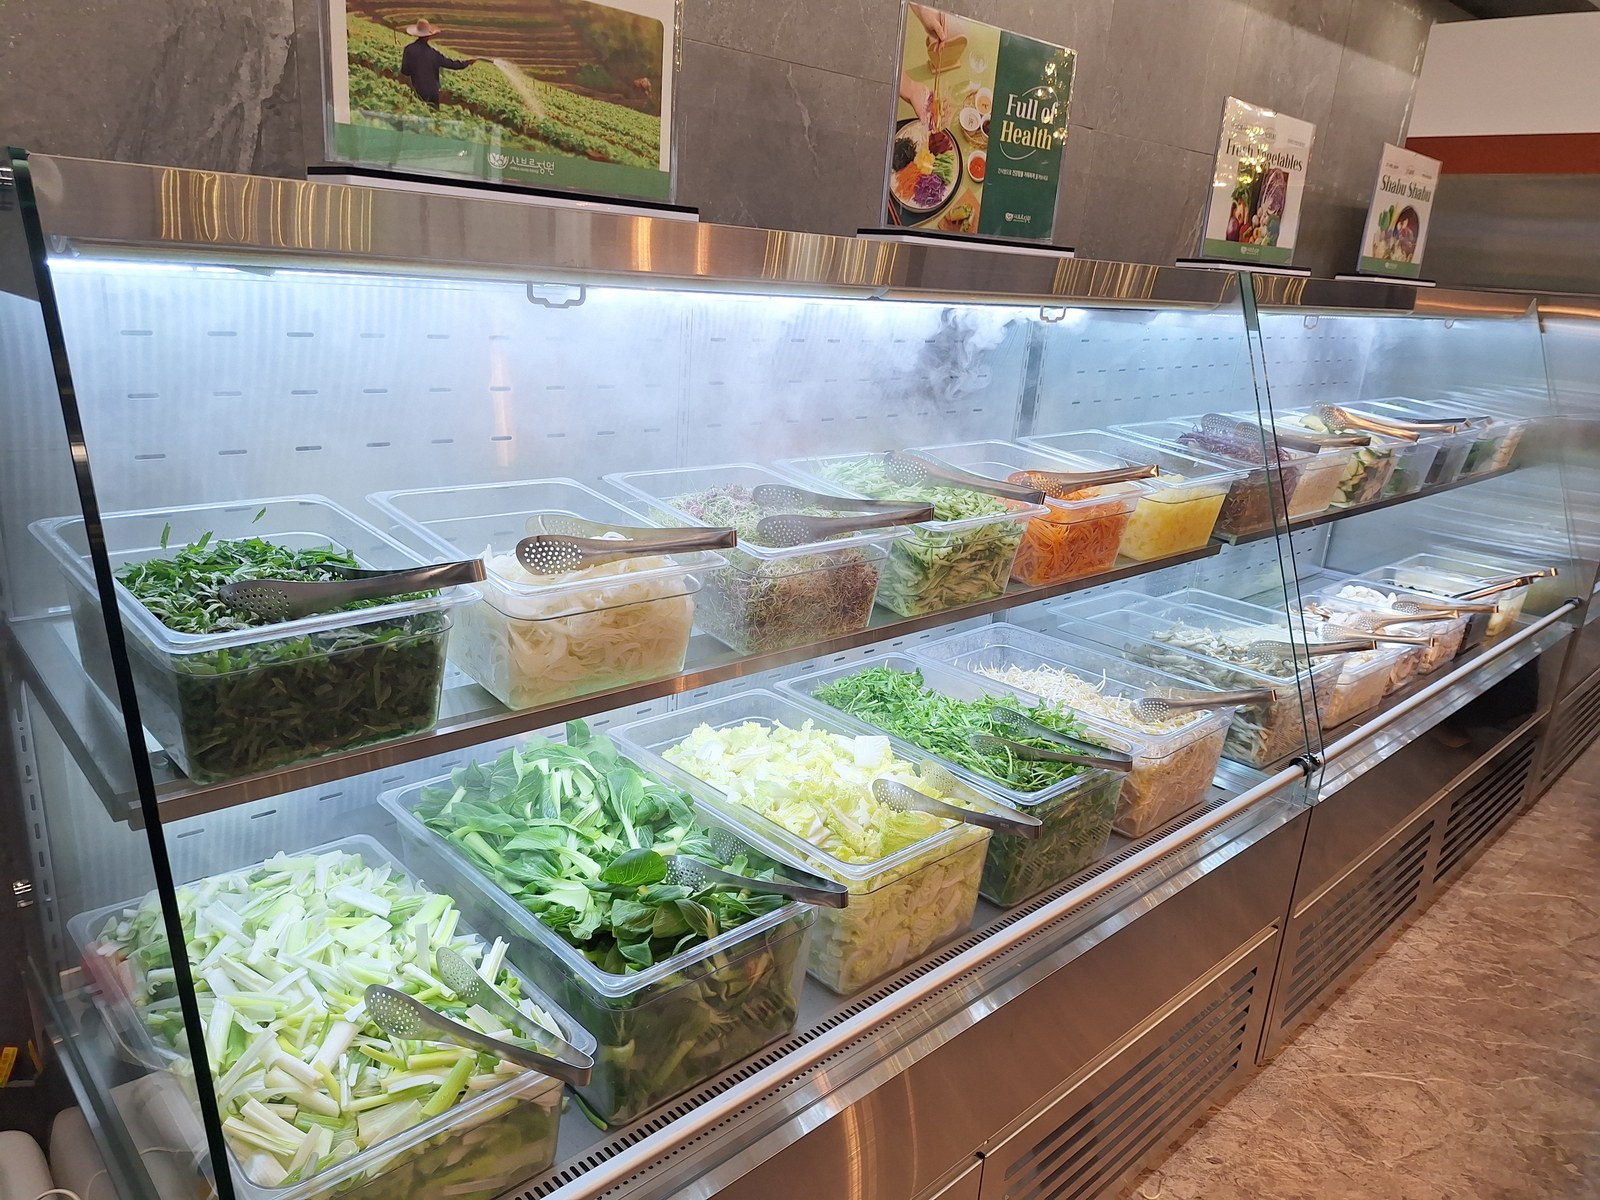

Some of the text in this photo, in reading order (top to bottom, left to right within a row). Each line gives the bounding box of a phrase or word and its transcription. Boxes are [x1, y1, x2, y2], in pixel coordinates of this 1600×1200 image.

[1006, 93, 1058, 125] Full of
[1000, 120, 1052, 151] Health
[1380, 174, 1431, 202] Shabu Shabu
